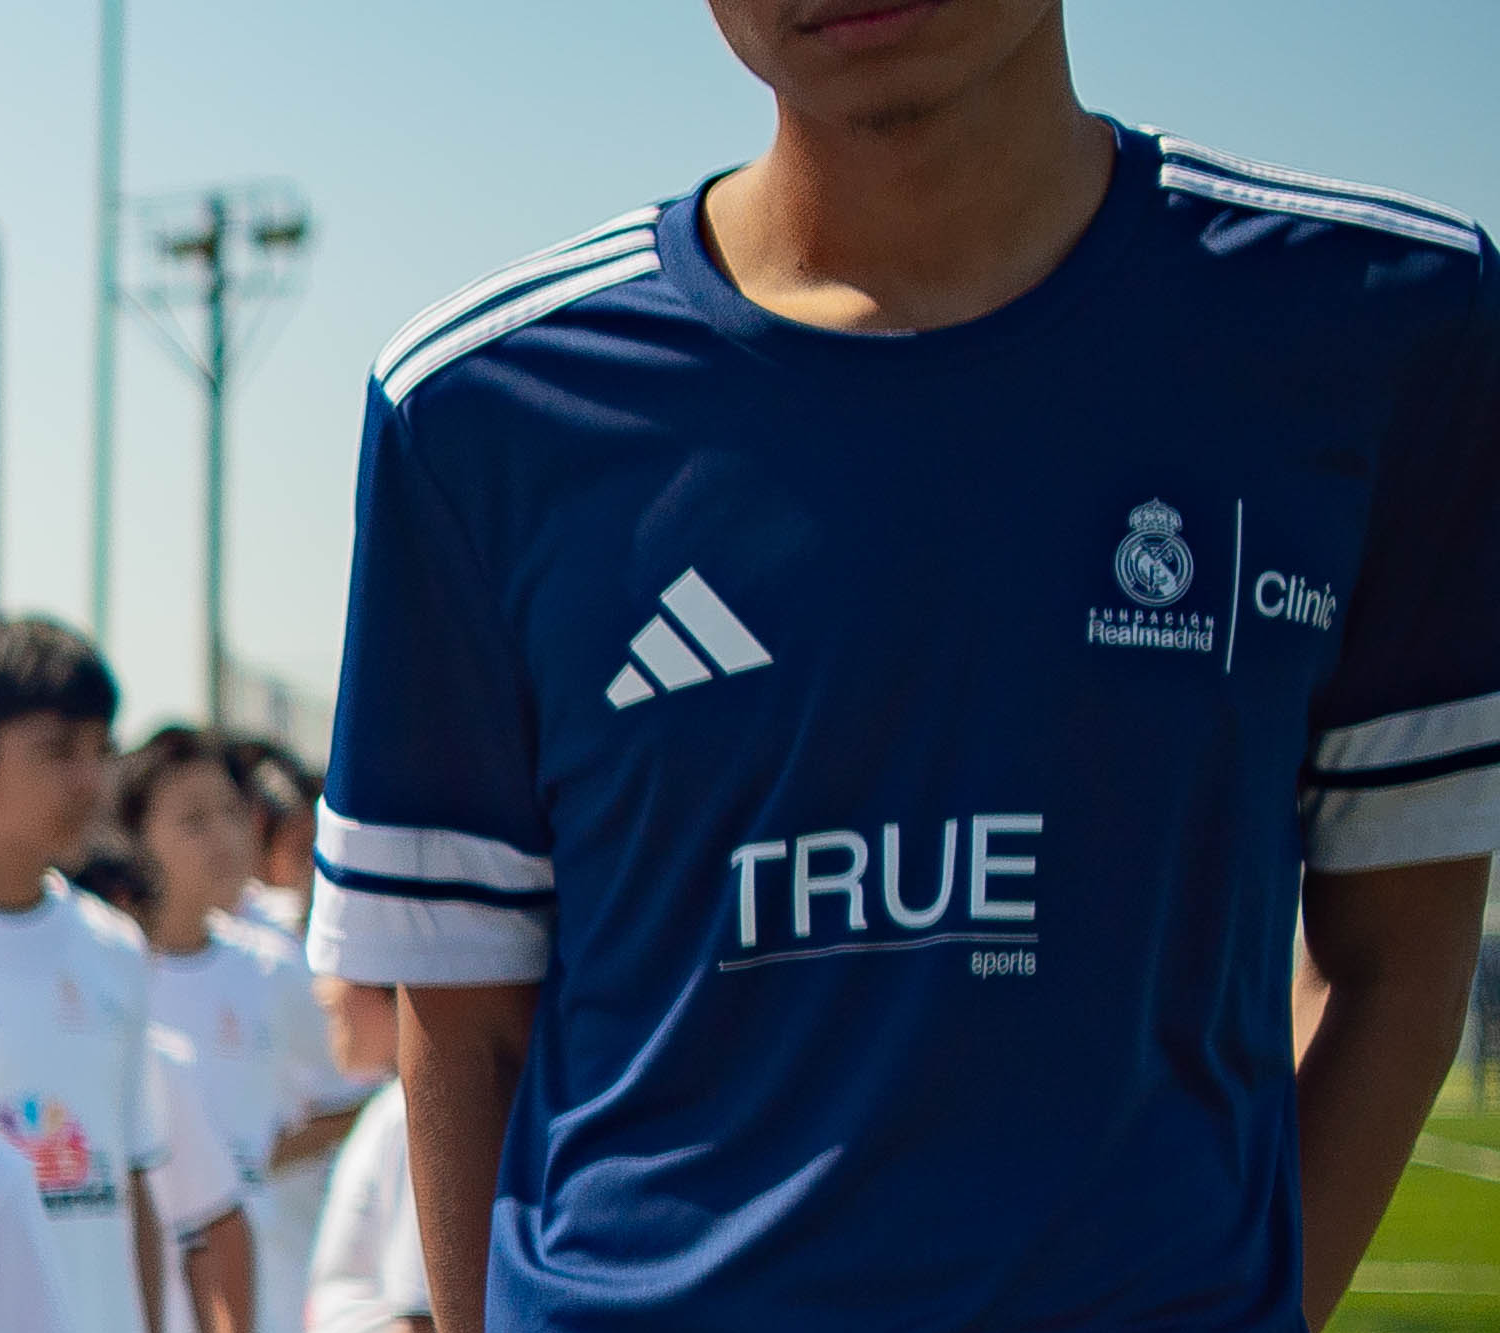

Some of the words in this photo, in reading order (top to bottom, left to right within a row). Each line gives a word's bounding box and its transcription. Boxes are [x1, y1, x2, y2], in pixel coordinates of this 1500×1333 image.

[1254, 570, 1337, 631] Clinic
[1088, 617, 1214, 652] Realmadrid
[730, 813, 1044, 948] TRUE
